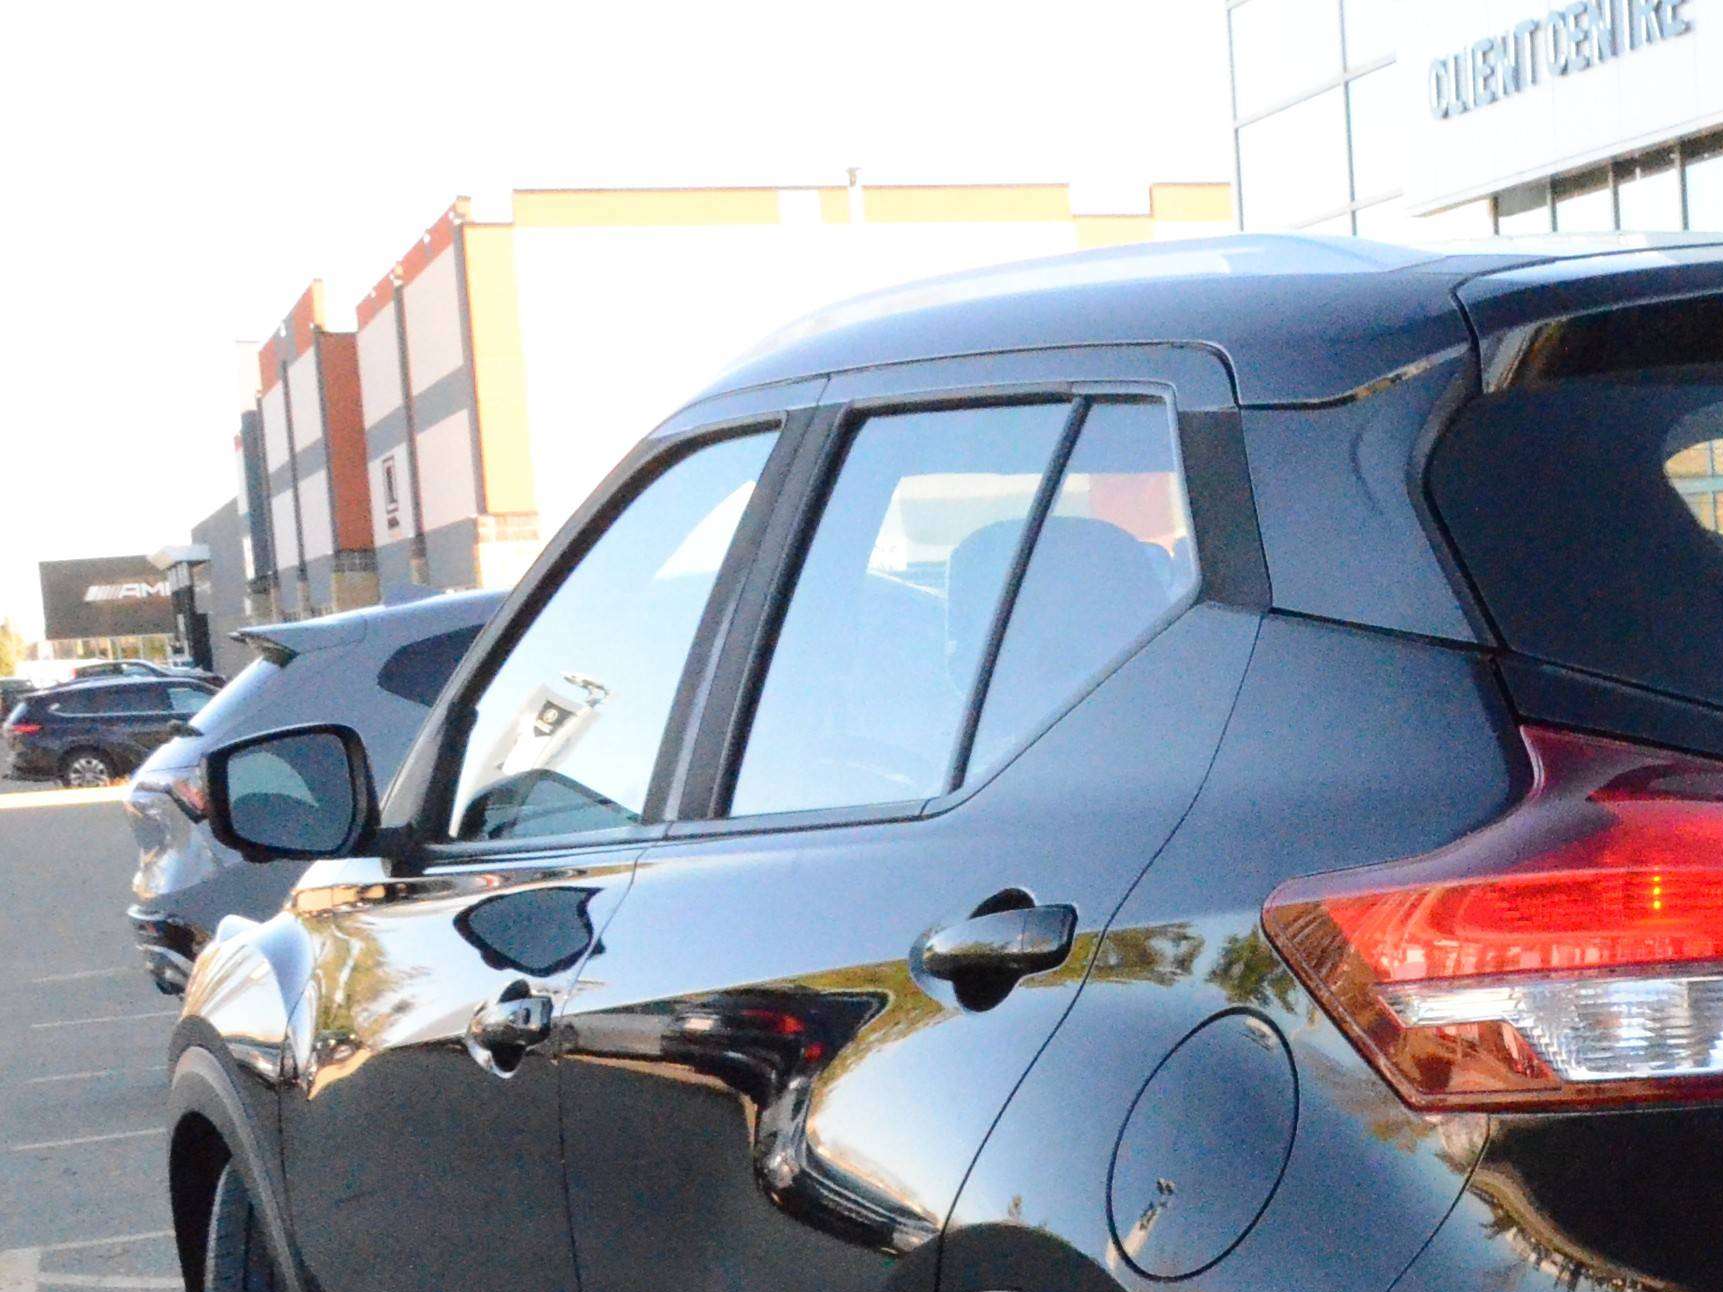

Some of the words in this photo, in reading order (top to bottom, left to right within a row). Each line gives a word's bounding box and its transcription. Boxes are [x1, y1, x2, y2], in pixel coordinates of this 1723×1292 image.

[1428, 18, 1541, 120] CLIENT
[1546, 0, 1696, 76] CENTRE
[119, 582, 171, 599] AM
